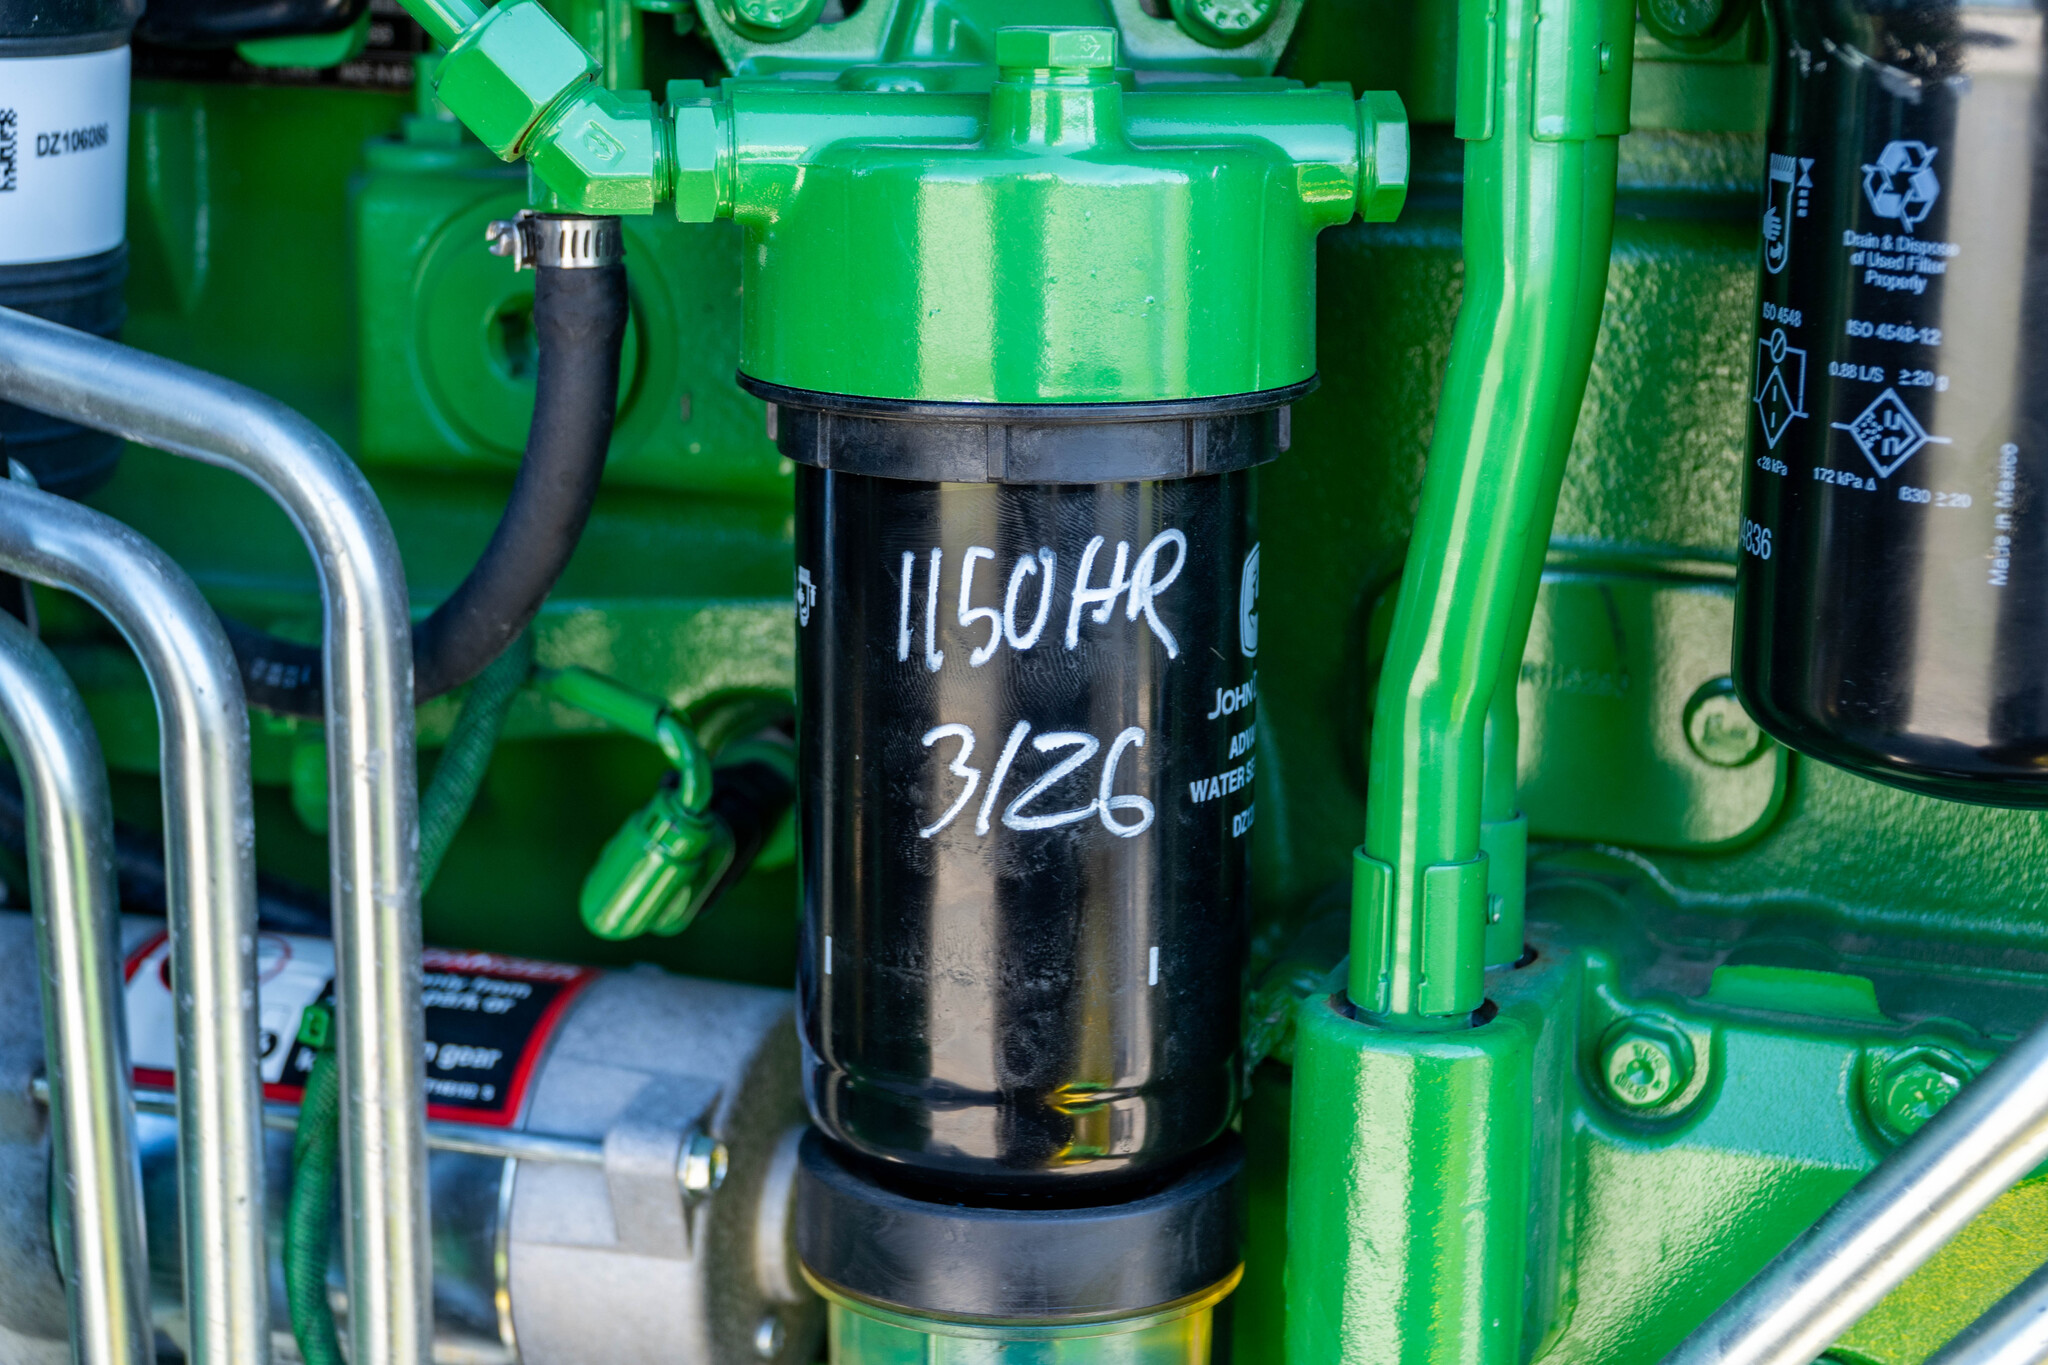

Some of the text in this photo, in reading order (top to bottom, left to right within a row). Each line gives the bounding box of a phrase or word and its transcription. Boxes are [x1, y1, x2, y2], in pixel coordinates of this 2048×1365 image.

[1842, 229, 1961, 257] Drain & Dispose
[1850, 251, 1947, 275] of Used Filter
[1864, 269, 1928, 295] Properly
[1763, 302, 1802, 328] ISO 4548
[1845, 319, 1942, 346] ISO 4548-12
[1813, 466, 1835, 484] 172
[1836, 472, 1863, 489] kPa
[1987, 442, 2019, 586] Made in Mexico
[1207, 679, 1253, 720] JOHN
[1189, 766, 1245, 804] WATER
[480, 996, 517, 1014] or
[436, 1043, 503, 1071] gear
